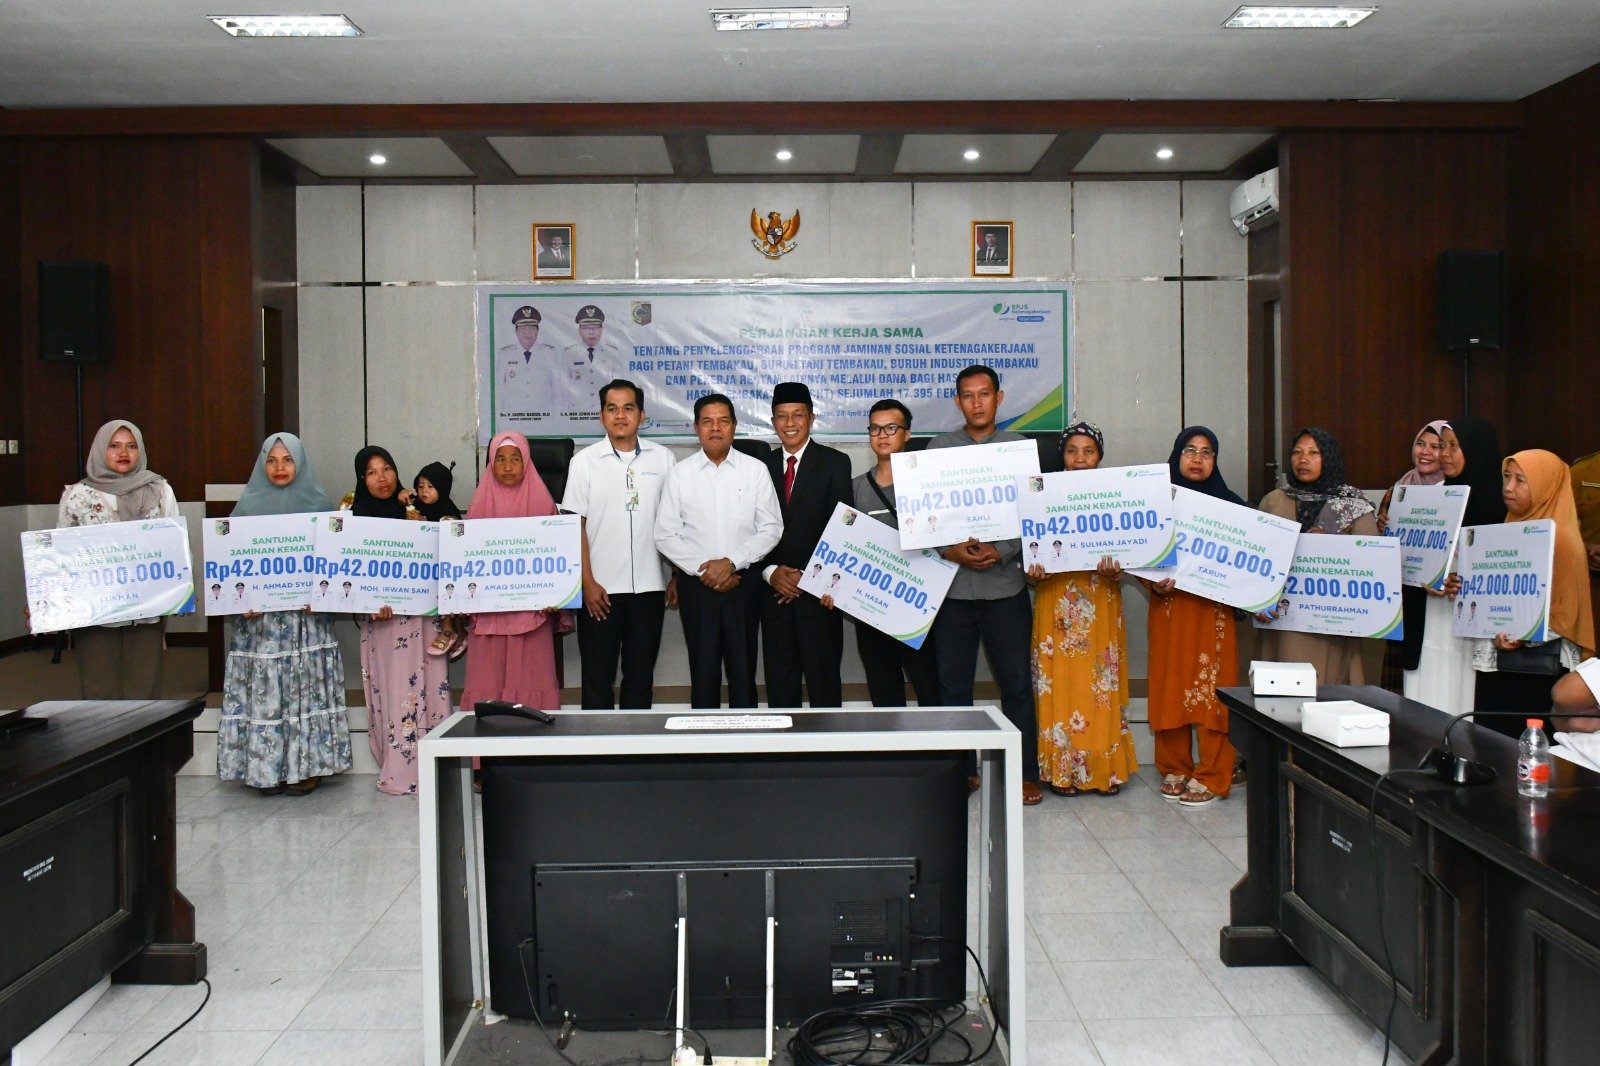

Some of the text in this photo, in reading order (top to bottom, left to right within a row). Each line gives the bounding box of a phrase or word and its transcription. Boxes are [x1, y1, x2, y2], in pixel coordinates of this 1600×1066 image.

[833, 328, 879, 337] KERJA
[884, 328, 923, 337] SAMA
[633, 343, 1034, 356] TENTANG PENYELENGGARAAN PROGRAM JAMINAN SOSIAL KETENAGAKERJAAN
[629, 358, 1038, 372] BAGI PETANI TEMBAKAU, BURUH TANI TEMBAKAU, BURUH INDUSTRI TEMBAKAU
[666, 375, 686, 385] DAN
[831, 374, 875, 384] MELALUI
[879, 374, 906, 383] DANA
[911, 374, 934, 383] BAGI
[938, 374, 957, 383] HAS
[838, 389, 893, 398] SEJUMLAH
[897, 388, 932, 398] 17.395
[940, 466, 993, 478] SANTUNAN
[920, 474, 1016, 490] JAMINAN KEMATIAN
[897, 485, 1017, 515] Rp42.000.00
[1067, 491, 1122, 501] SANTUNAN
[1046, 500, 1146, 514] JAMINAN KEMATIAN
[1022, 510, 1172, 540] Rp42.000.000,-
[1193, 514, 1247, 537] SANTUNAN
[252, 536, 306, 545] SANTUNAN
[485, 538, 536, 546] SANTUNAN
[1174, 520, 1266, 553] AMINAN KEMATIAN
[230, 544, 314, 556] JAMINAN KEMATI
[363, 539, 414, 548] SANTUNAN
[1080, 540, 1114, 549] SULHAN
[1116, 538, 1147, 546] JAYADI
[105, 551, 162, 564] KEMATIAN
[341, 548, 433, 559] JAMINAN KEMATIAN
[464, 546, 557, 557] JAMINAN KEMATIAN
[865, 541, 911, 568] SANTUNAN
[1176, 532, 1285, 581] 2.000.000,-
[1485, 550, 1518, 558] SANTUNAN
[842, 541, 881, 564] JAMINAN
[881, 560, 924, 586] KEMATIAN
[1296, 556, 1350, 565] SANTUNAN
[1472, 561, 1531, 570] JAMINAN KEMATIAN
[206, 555, 314, 582] Rp42.000.0
[315, 556, 439, 580] Rp42.000.000
[440, 556, 580, 582] Rp42.000.000,-
[1198, 566, 1226, 580] TARUM
[1322, 567, 1374, 577] KEMATIAN
[814, 541, 936, 615] Rp42.000.000,-
[263, 582, 293, 590] AHMAD
[1282, 576, 1400, 604] 2.000.000,-
[856, 588, 889, 608] H. HASAN
[1299, 604, 1368, 614] PATHURRAHMAN
